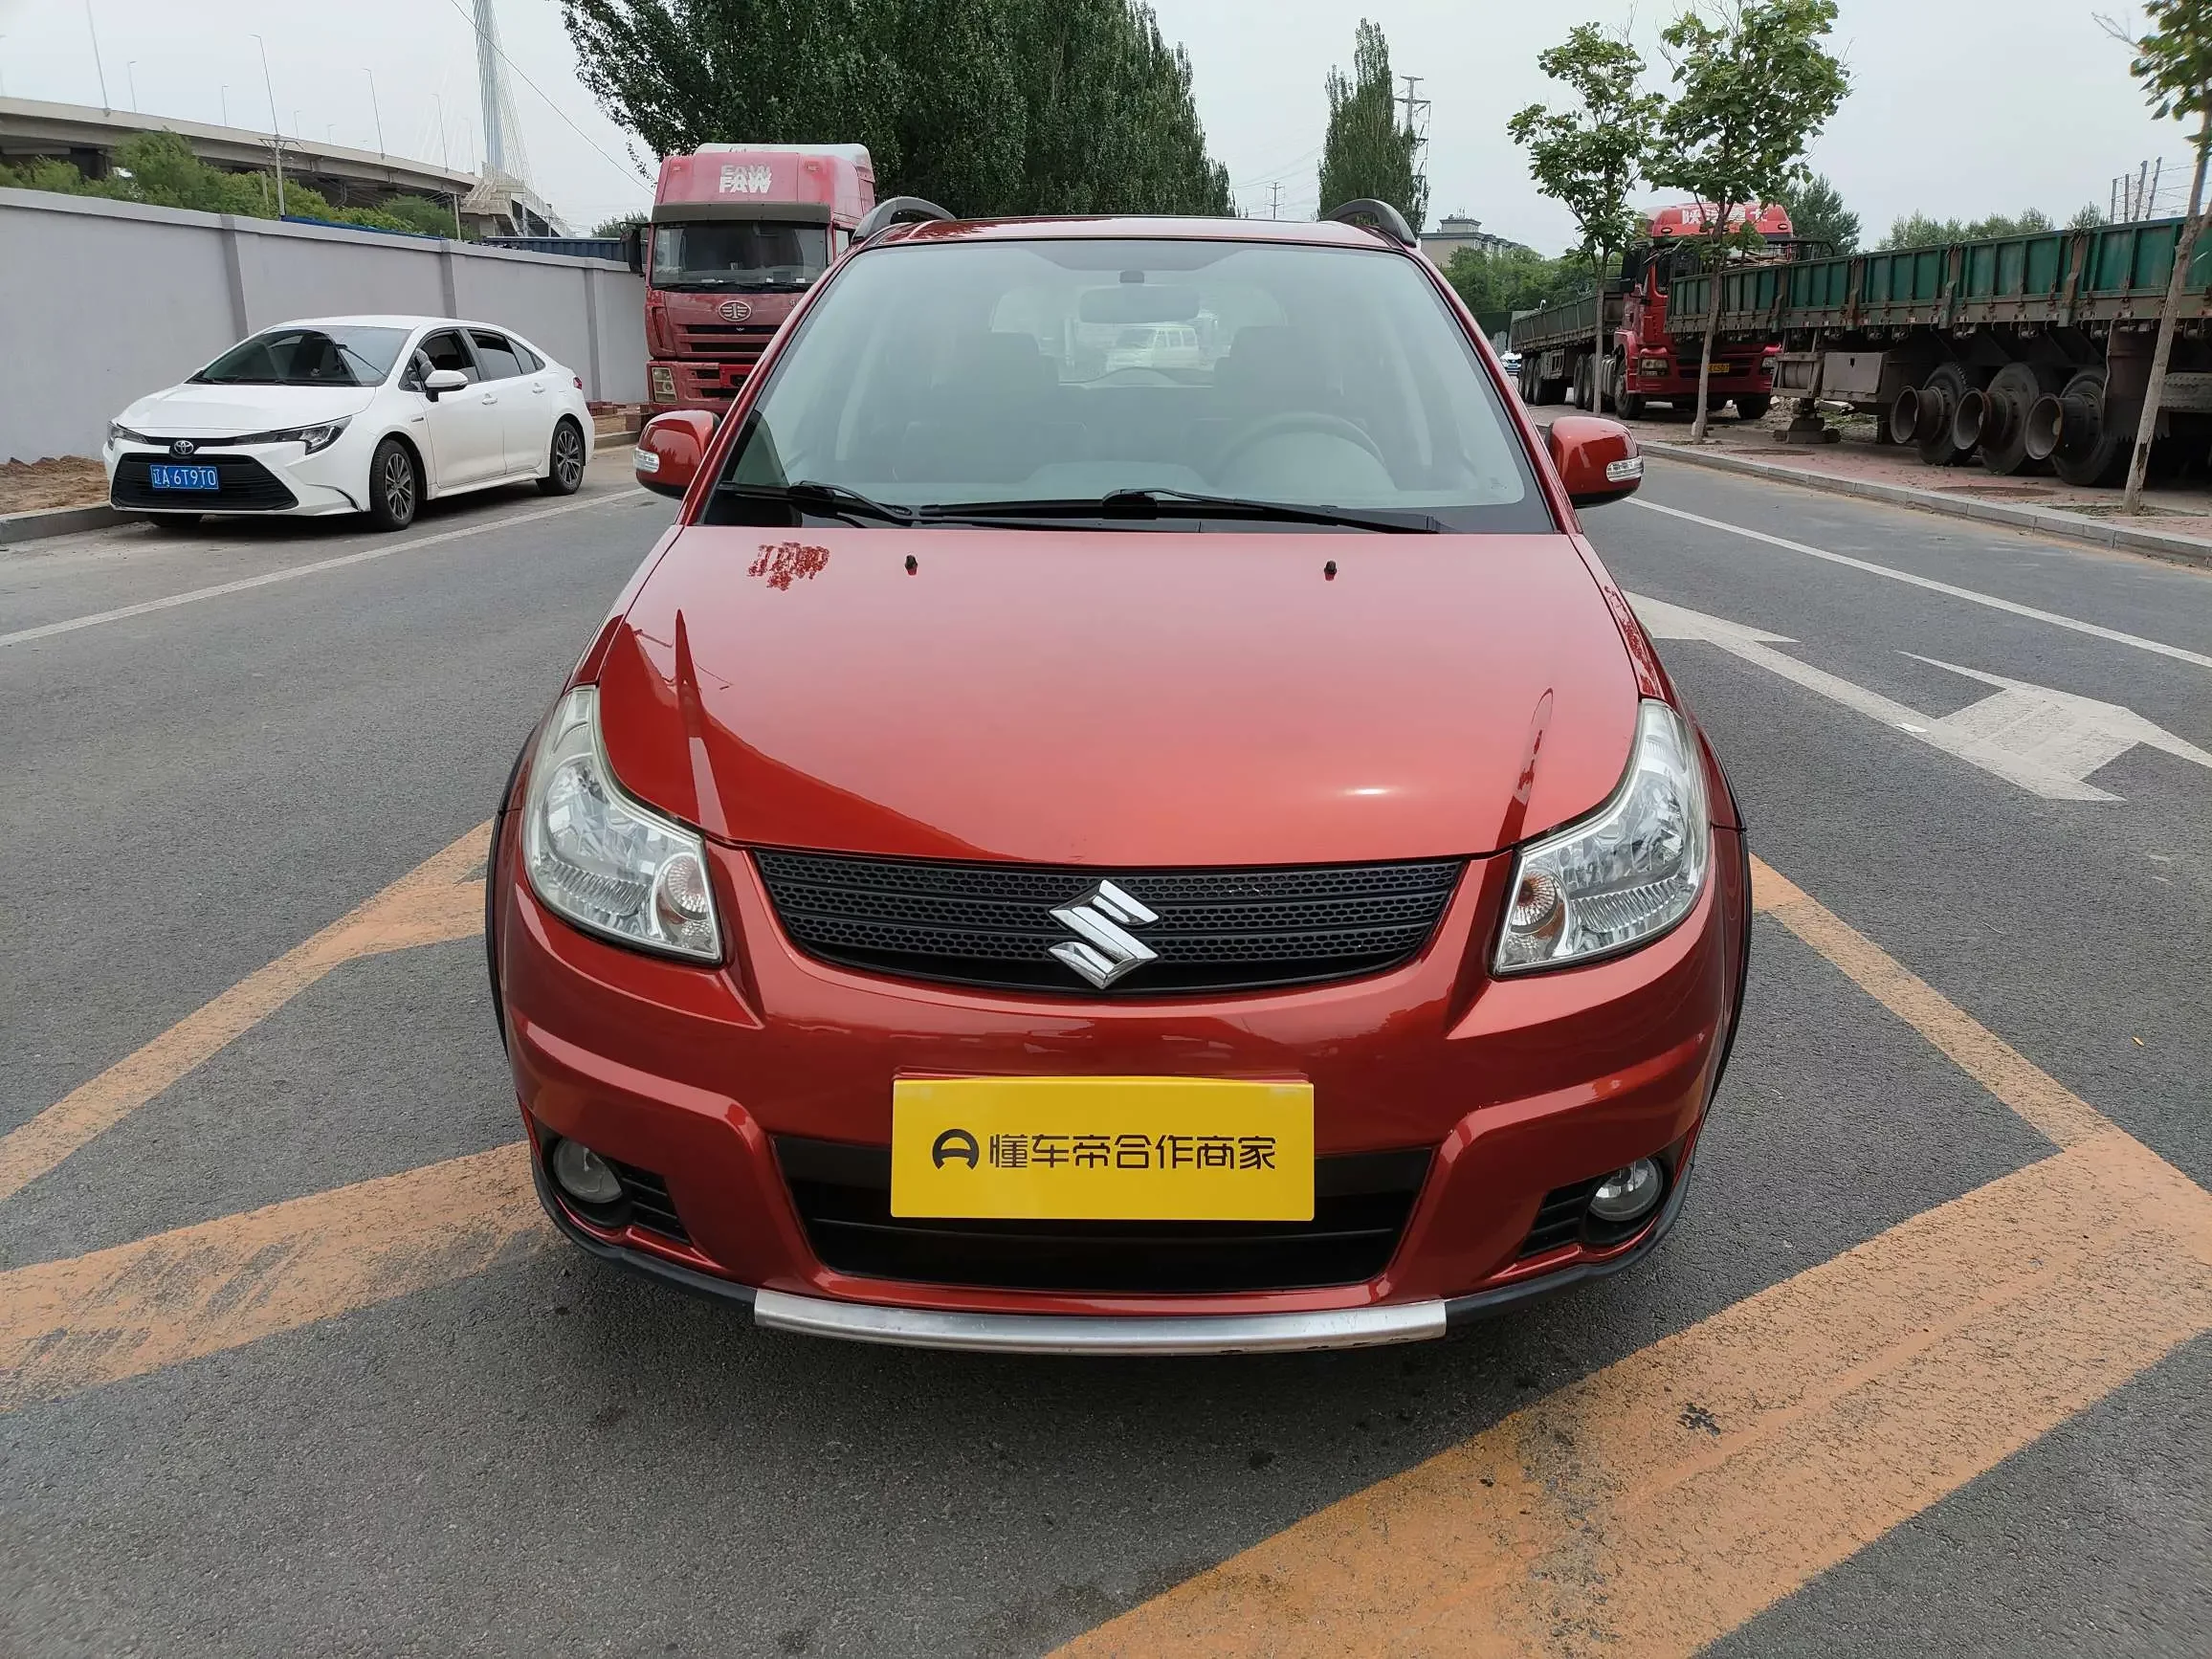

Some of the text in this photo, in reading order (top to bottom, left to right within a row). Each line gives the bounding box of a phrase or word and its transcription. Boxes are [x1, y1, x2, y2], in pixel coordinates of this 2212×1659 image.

[719, 175, 772, 193] FAW
[989, 1133, 1277, 1170] 懂车帝合作商家
